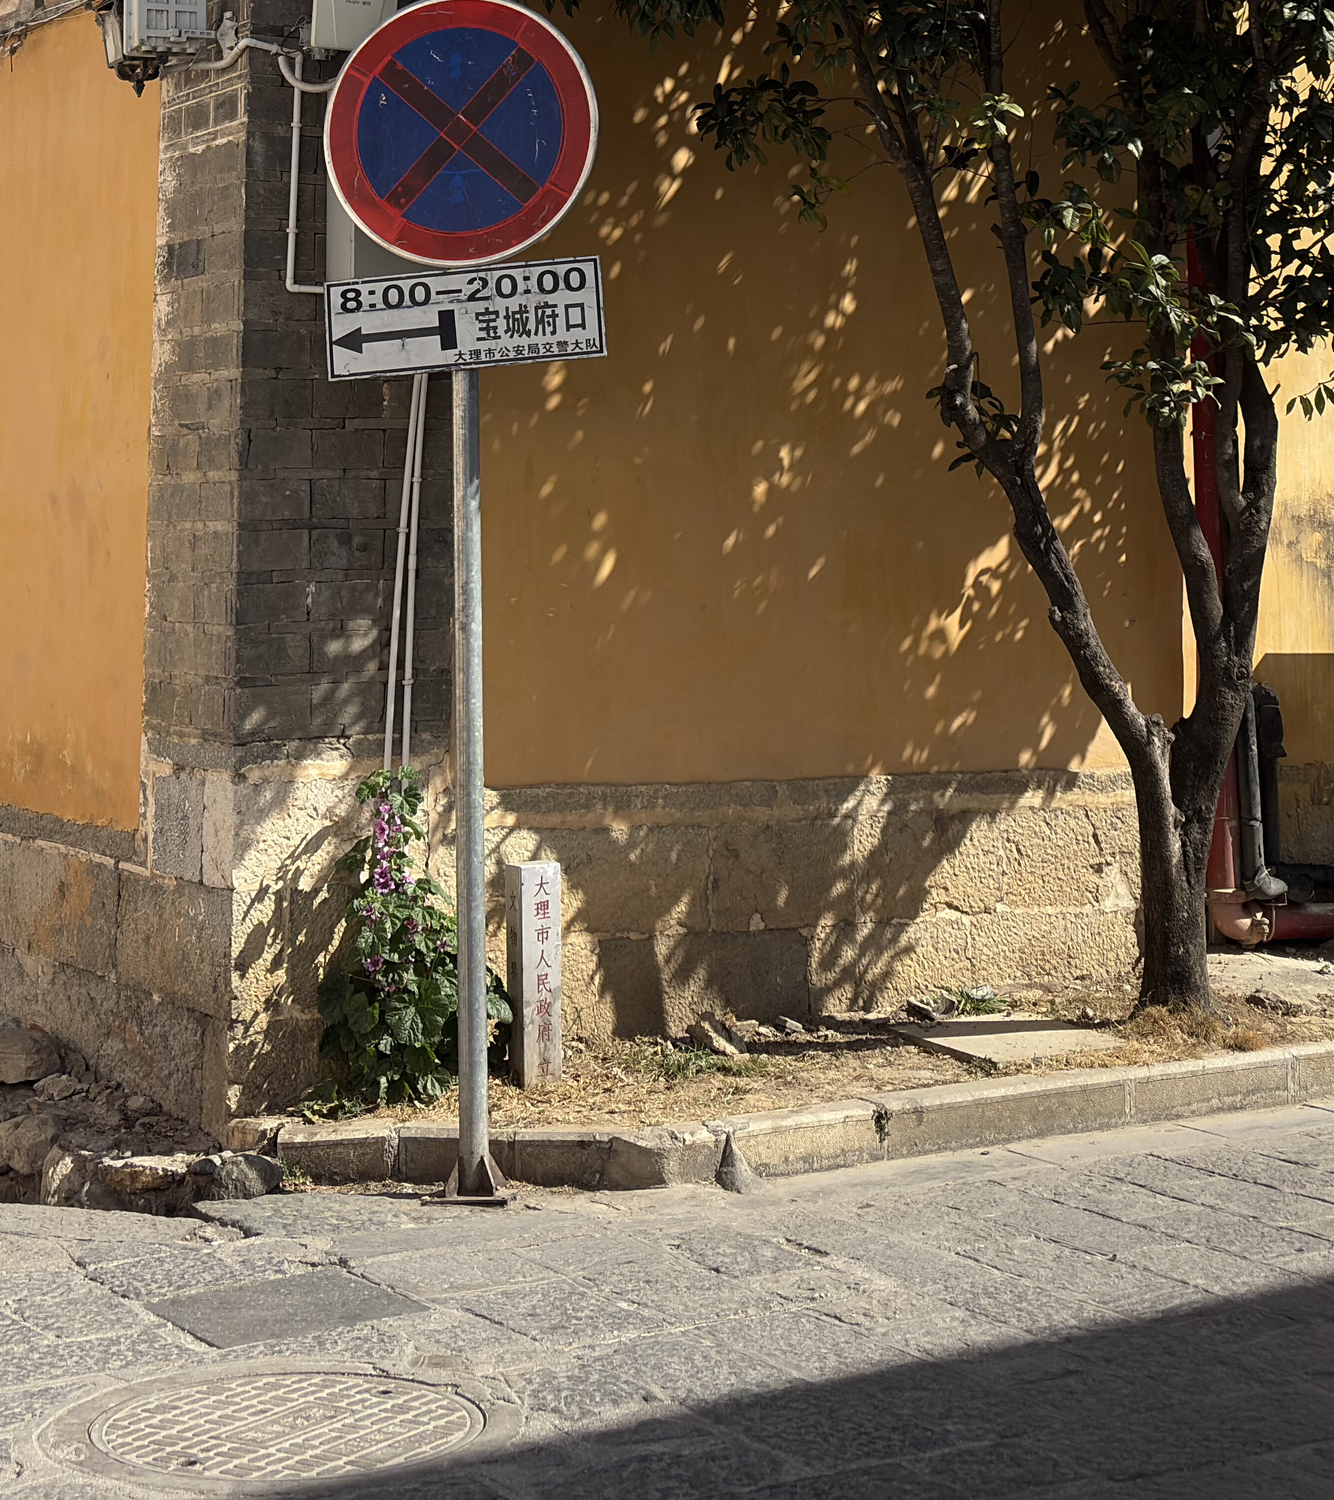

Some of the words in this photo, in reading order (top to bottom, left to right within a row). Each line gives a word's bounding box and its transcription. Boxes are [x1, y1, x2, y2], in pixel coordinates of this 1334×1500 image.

[475, 301, 587, 342] 宝城府口
[454, 338, 599, 362] 大理市公安局交警大队
[533, 875, 554, 1079] 大理市人民政府立
